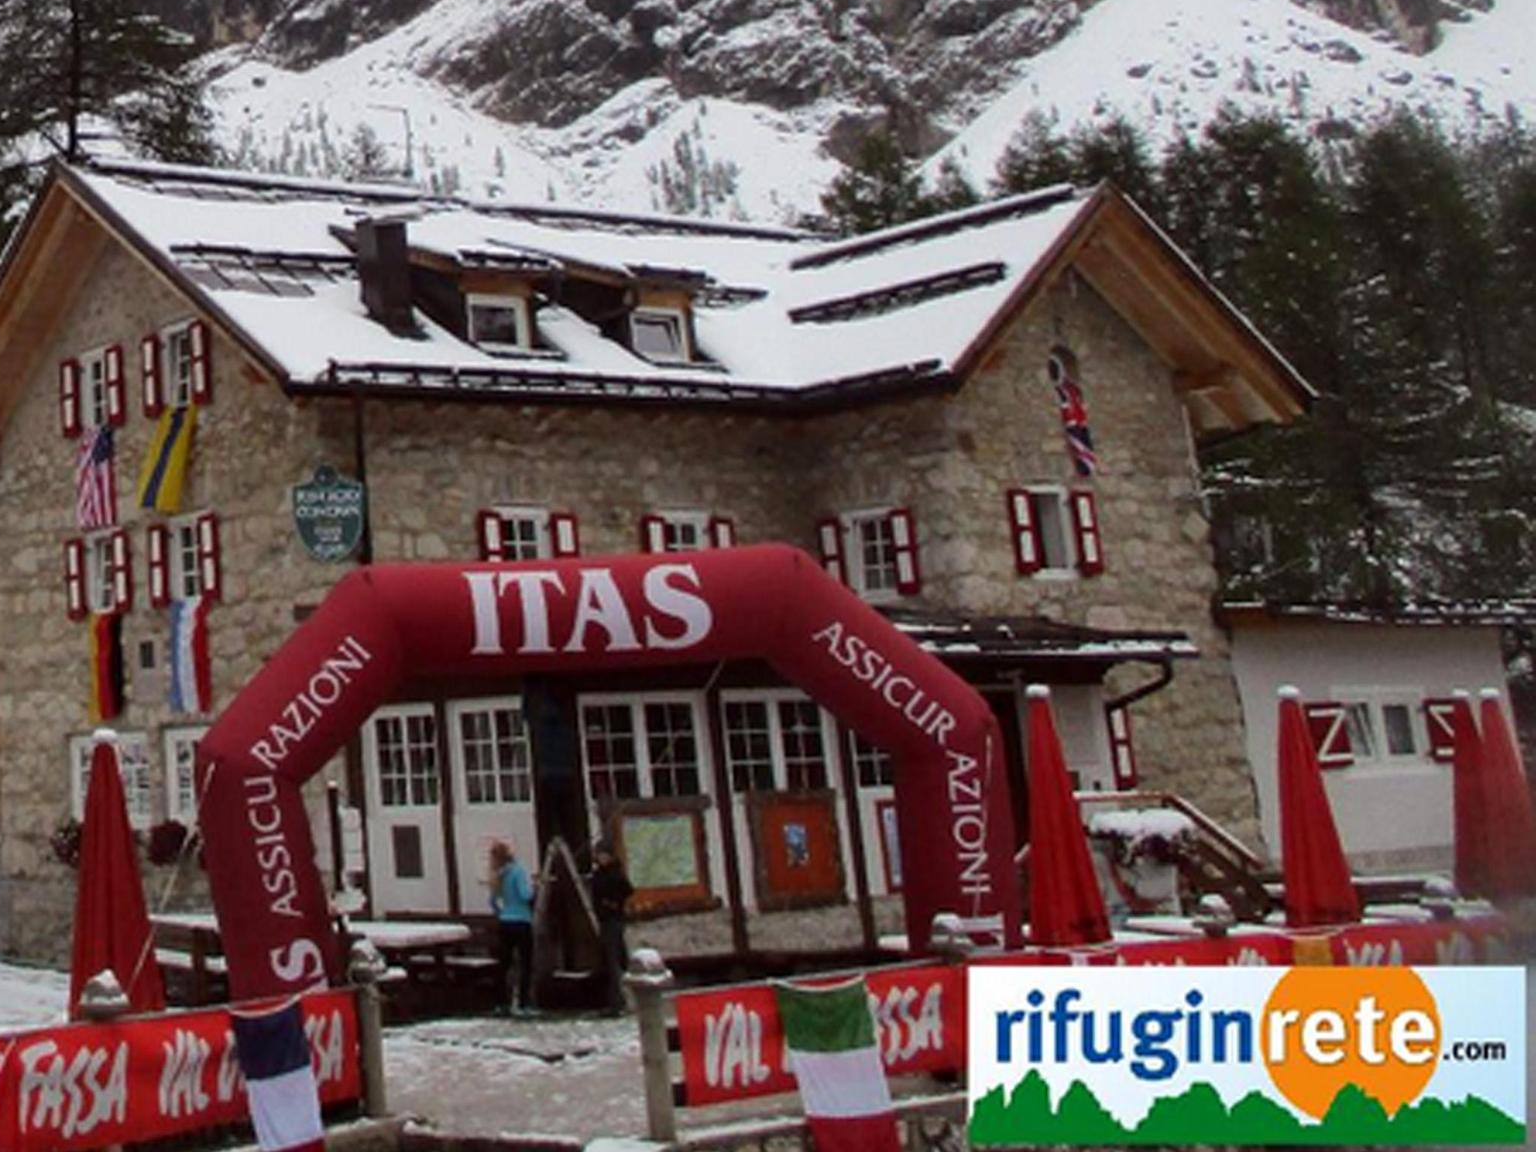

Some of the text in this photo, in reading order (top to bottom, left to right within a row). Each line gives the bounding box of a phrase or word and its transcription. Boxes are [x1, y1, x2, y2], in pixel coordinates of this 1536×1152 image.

[462, 563, 714, 655] ITAS
[19, 1040, 129, 1139] FASSA
[158, 1028, 210, 1118] VAL
[704, 1002, 771, 1089] VAL
